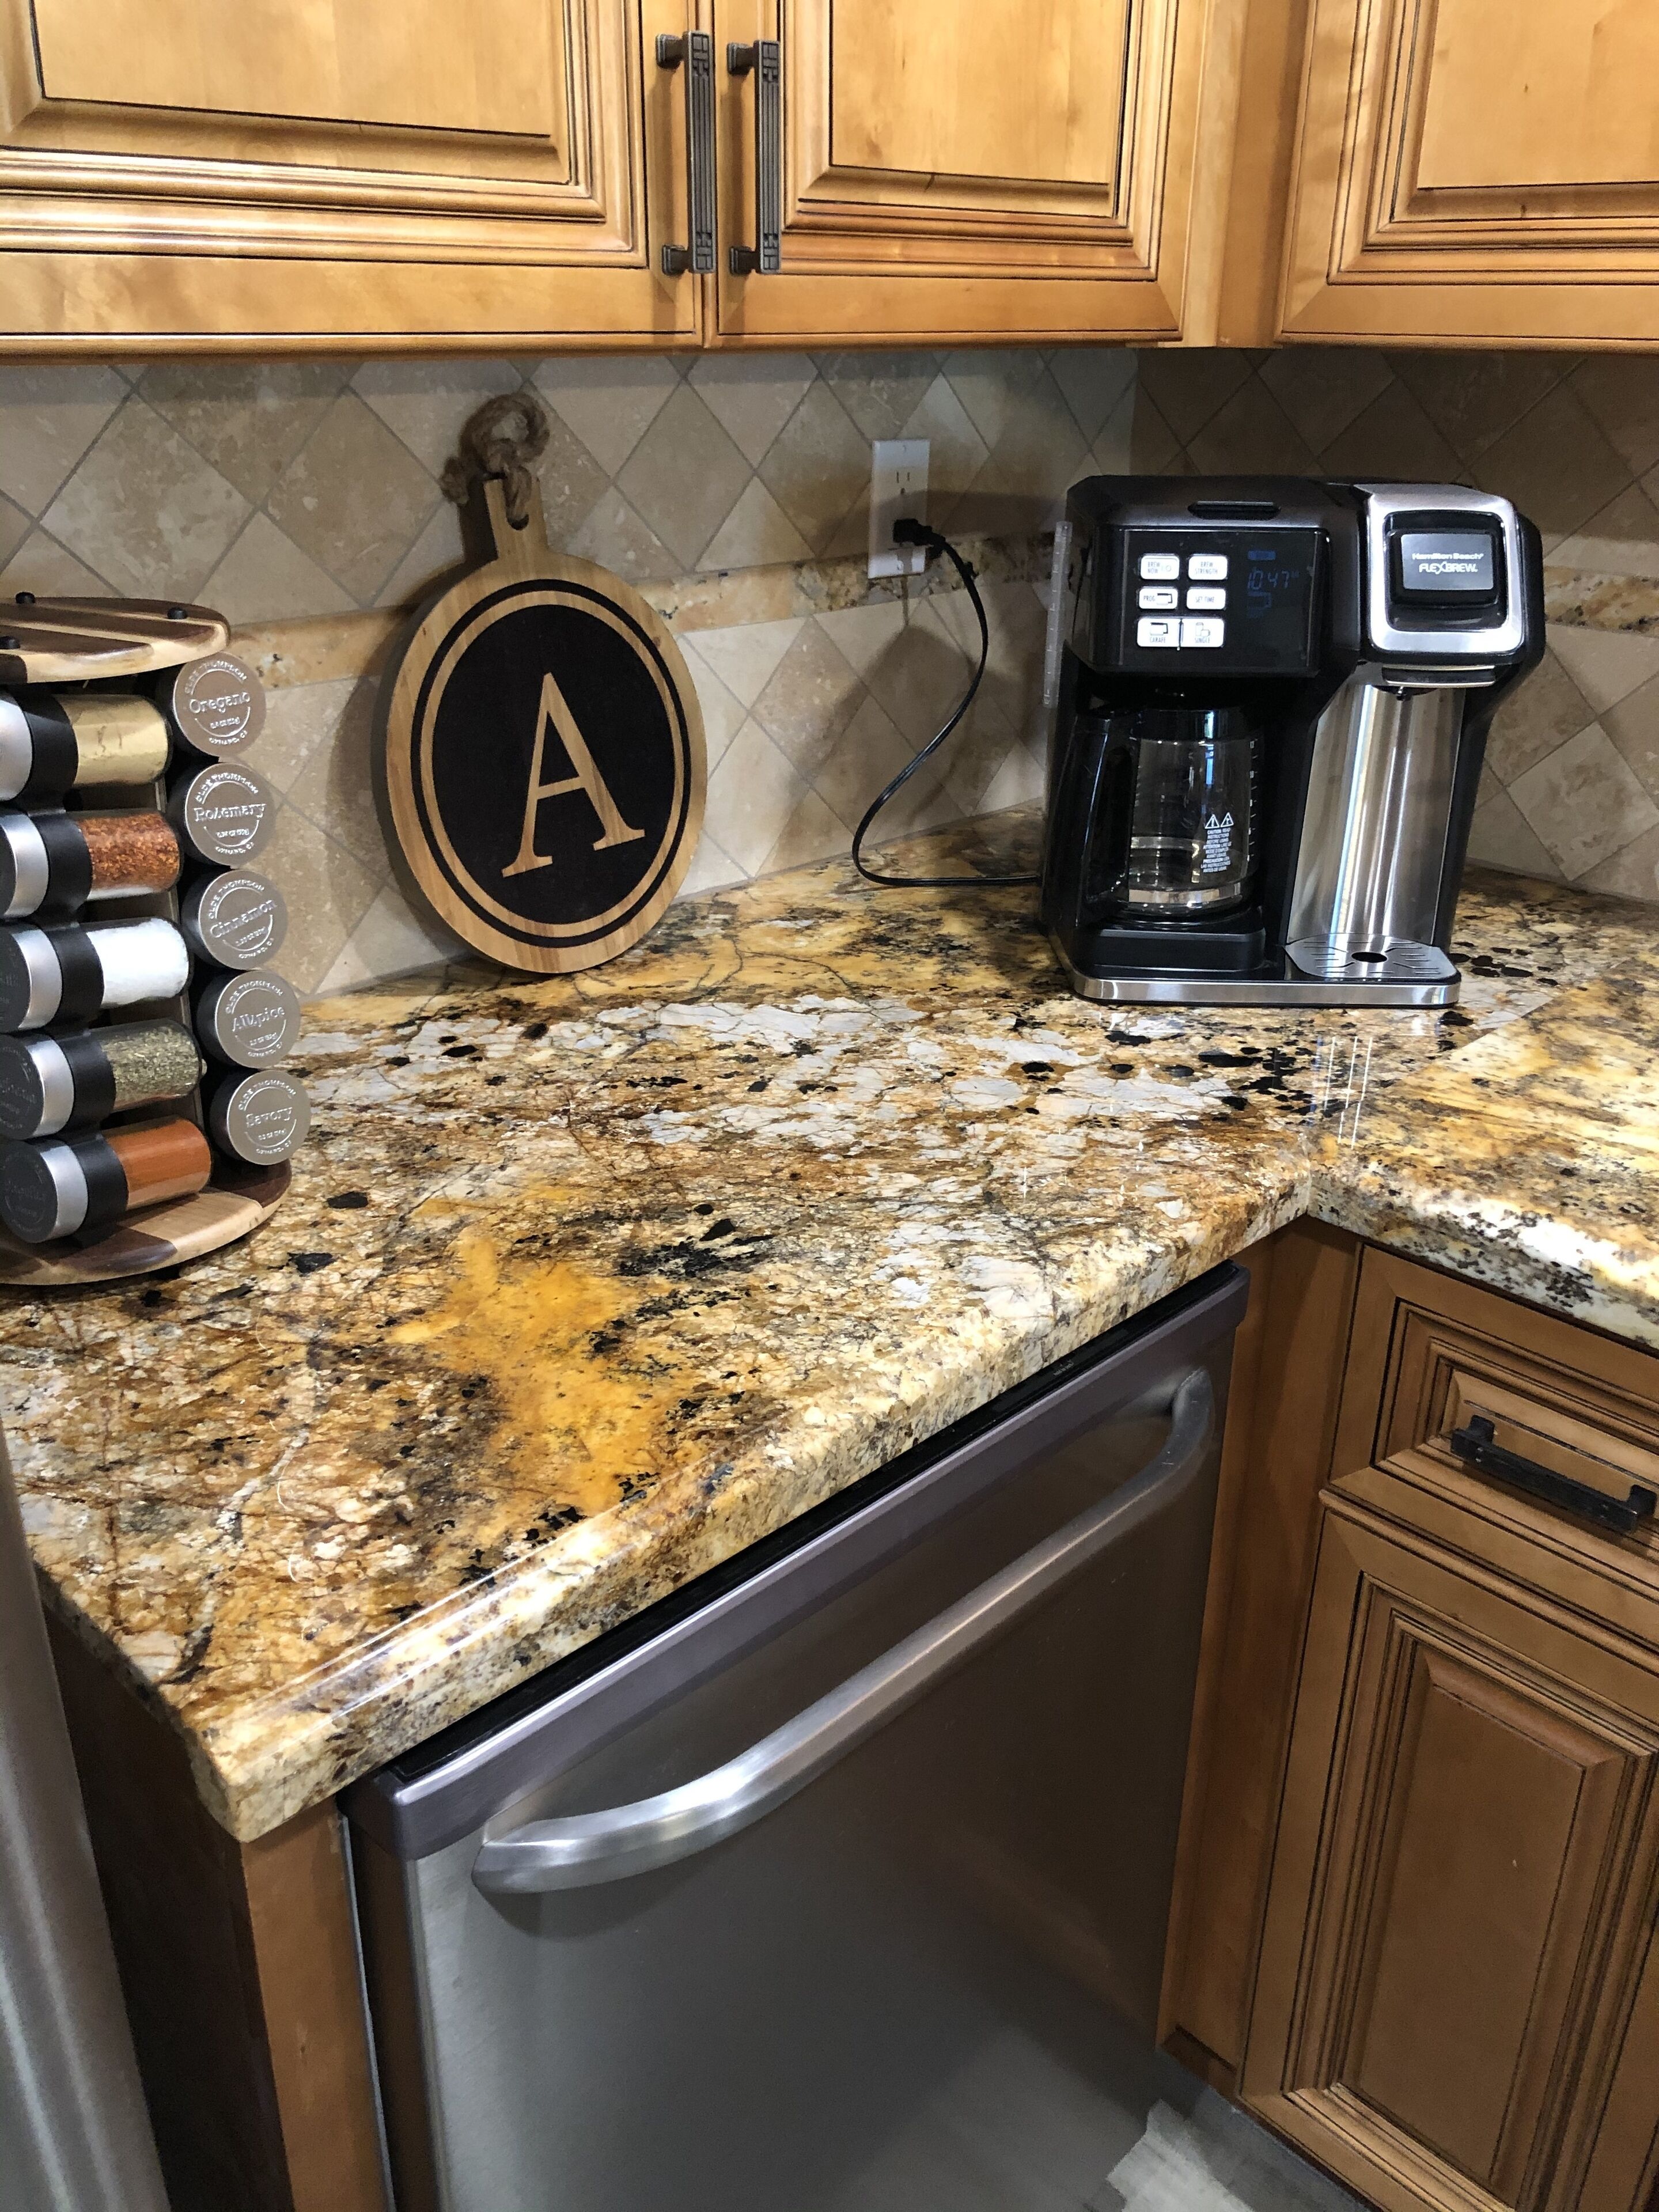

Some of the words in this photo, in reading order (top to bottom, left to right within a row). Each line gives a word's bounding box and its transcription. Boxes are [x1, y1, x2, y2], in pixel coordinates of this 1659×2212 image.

[190, 692, 250, 713] Oregano
[501, 672, 645, 877] A
[194, 803, 267, 822] Rosemary
[210, 900, 278, 938] Cinnamon
[232, 1007, 285, 1032] Allspice
[246, 1107, 293, 1128] Savory
